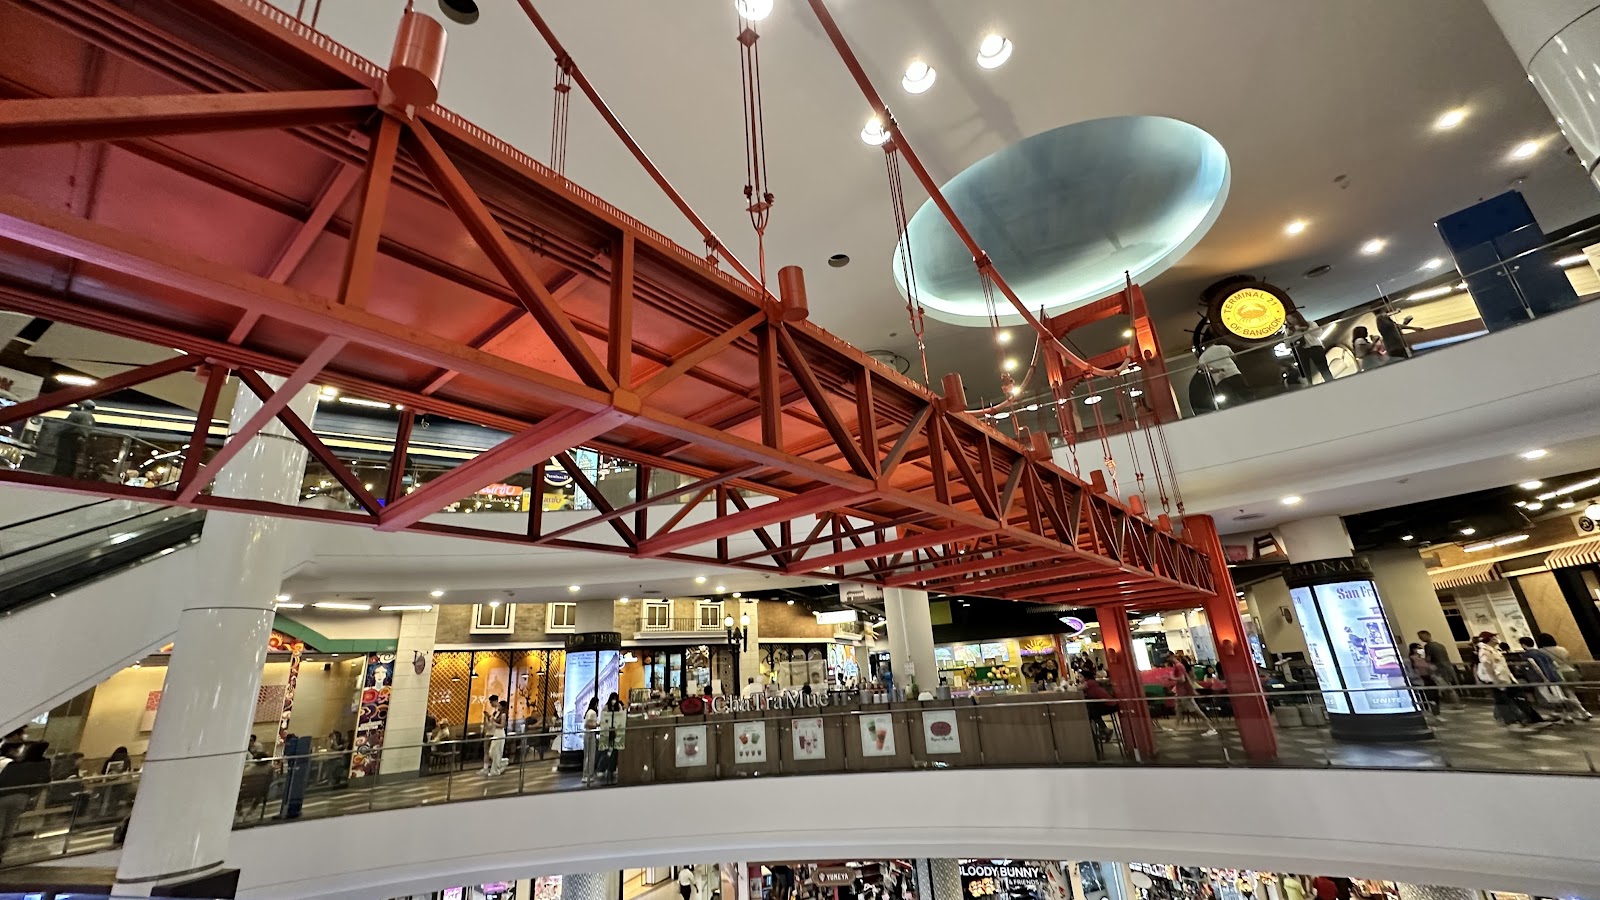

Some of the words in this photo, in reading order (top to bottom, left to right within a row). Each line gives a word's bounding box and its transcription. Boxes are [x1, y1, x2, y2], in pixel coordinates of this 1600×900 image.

[1224, 291, 1264, 314] TERMINAL
[1267, 297, 1278, 307] 21
[1230, 322, 1242, 333] OF
[1242, 317, 1282, 336] BANGKOK
[1337, 587, 1360, 599] San
[1000, 866, 1039, 878] BUNNY
